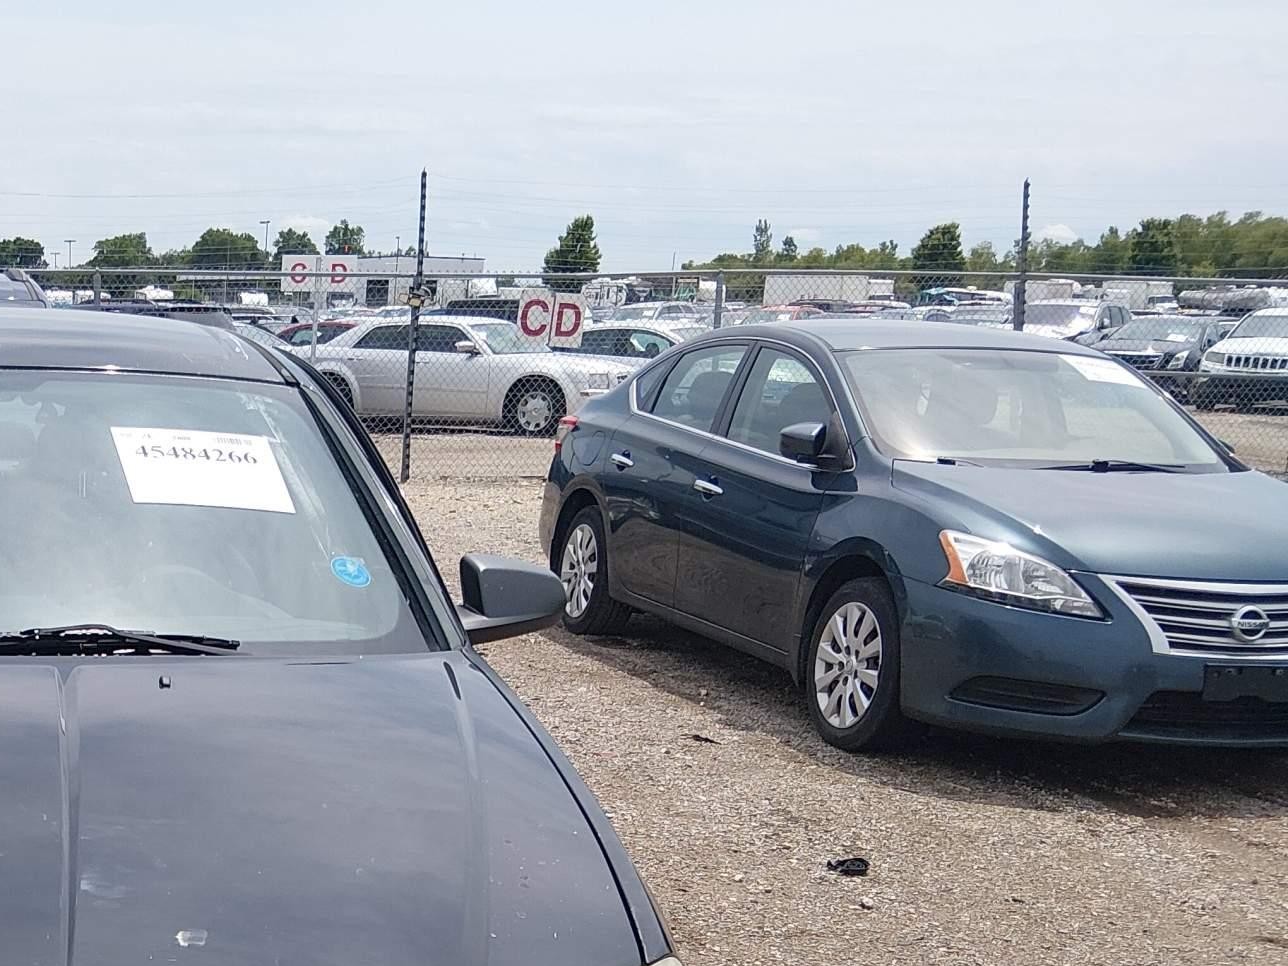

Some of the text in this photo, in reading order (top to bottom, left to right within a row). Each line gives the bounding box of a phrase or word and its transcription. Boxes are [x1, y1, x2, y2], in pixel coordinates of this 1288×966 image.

[290, 263, 347, 283] C D
[135, 445, 258, 464] 45484266
